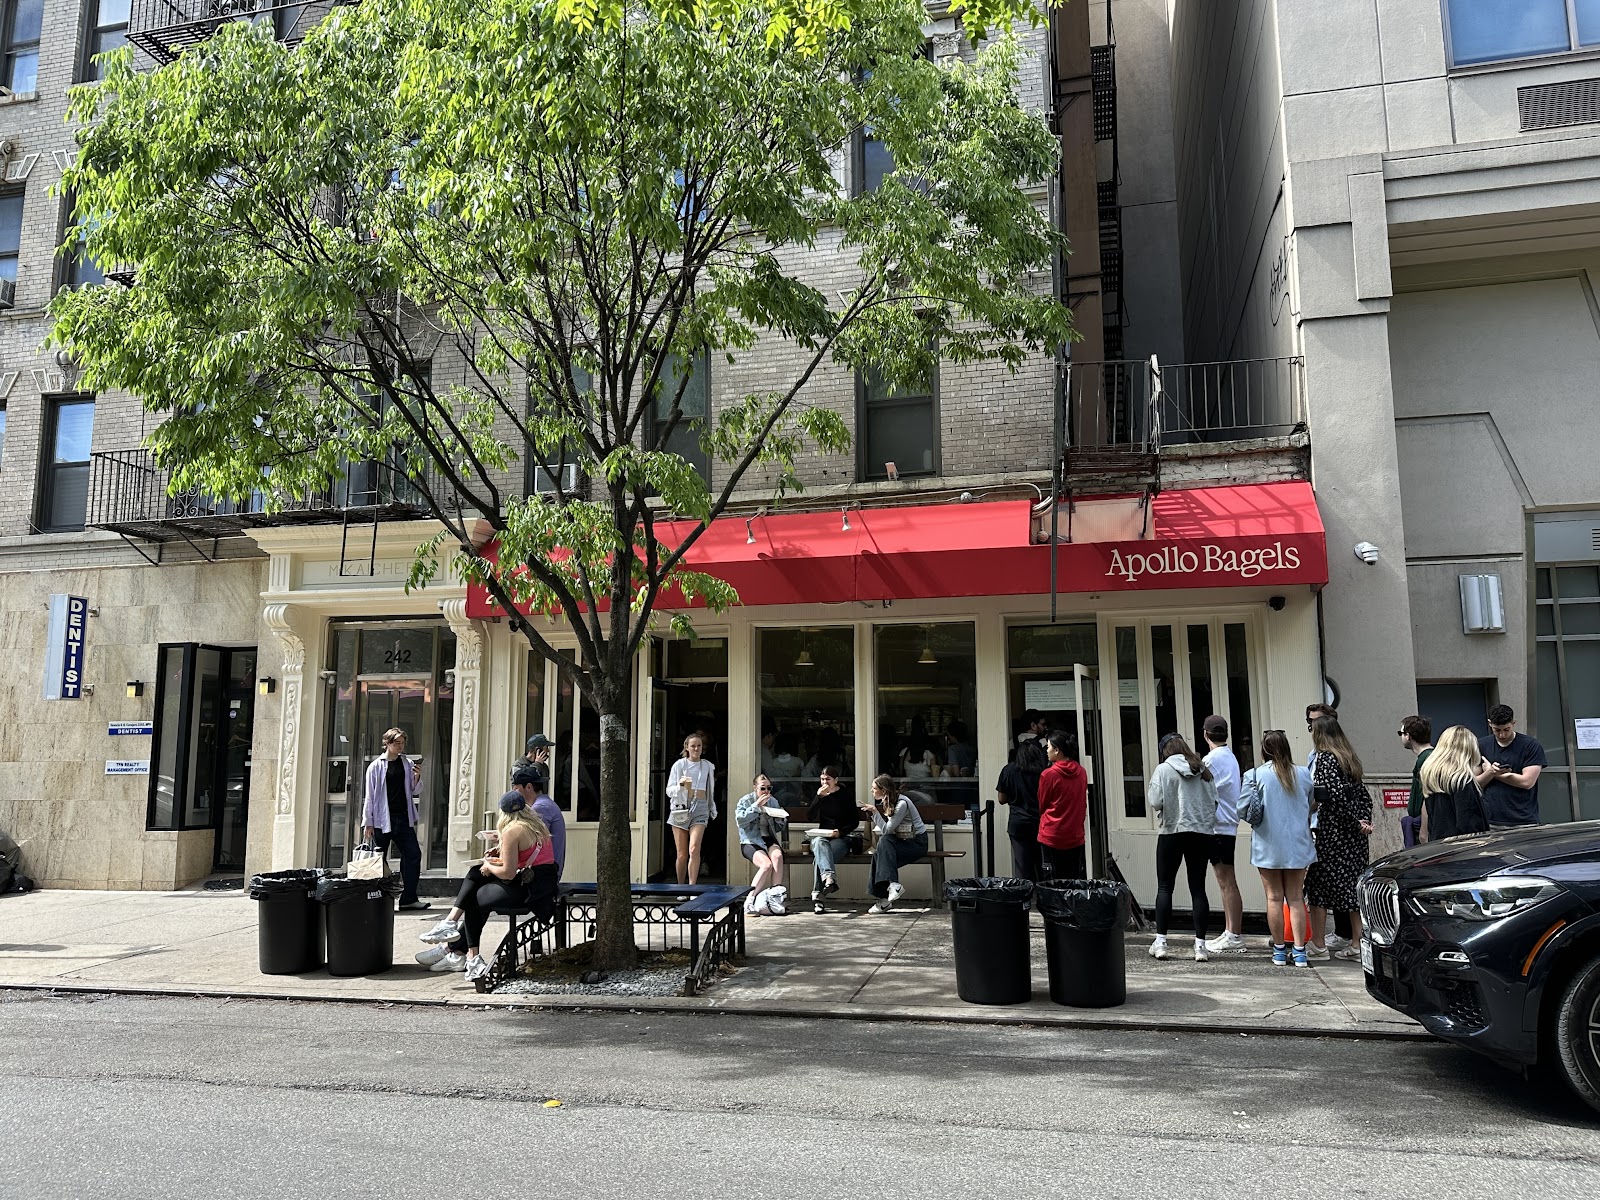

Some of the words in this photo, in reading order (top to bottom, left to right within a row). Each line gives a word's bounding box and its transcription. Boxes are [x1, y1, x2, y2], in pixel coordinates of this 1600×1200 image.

[1105, 545, 1198, 582] Apollo
[1201, 541, 1300, 578] Bagels
[64, 599, 84, 697] DENTIST
[384, 649, 411, 664] 242
